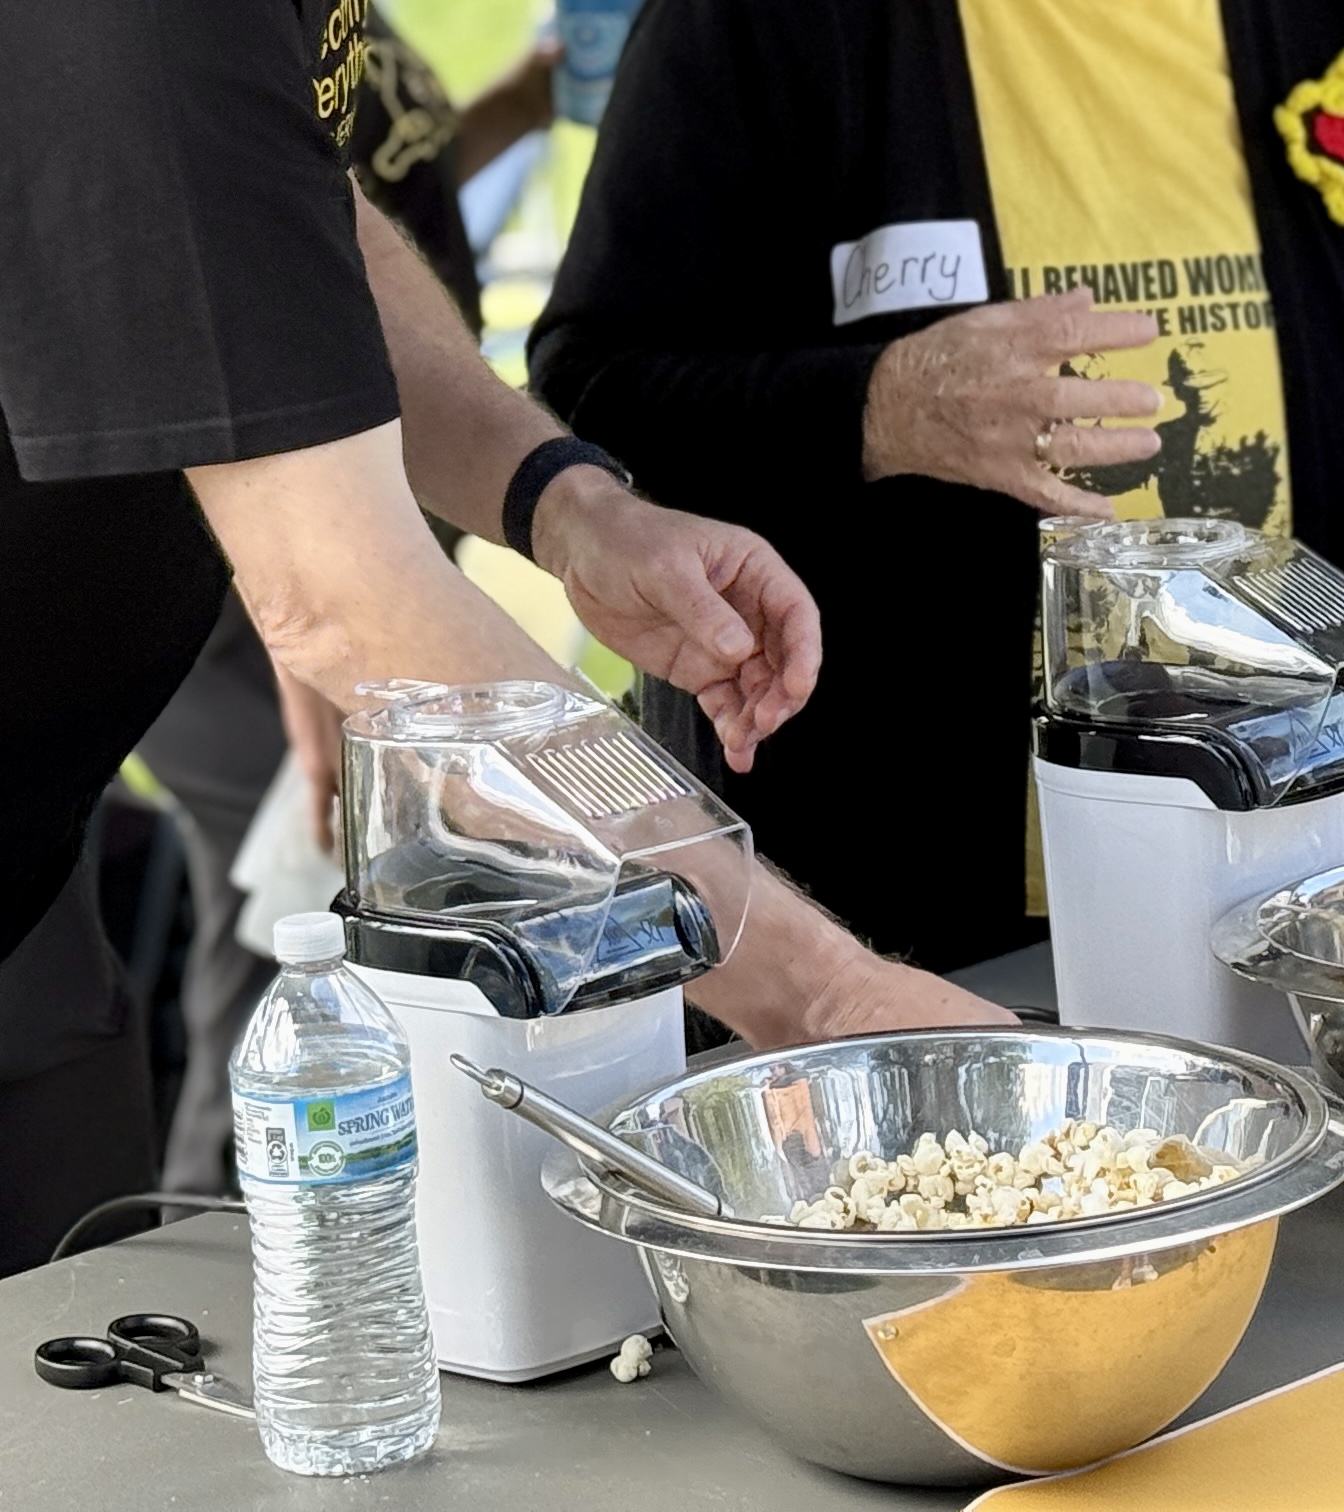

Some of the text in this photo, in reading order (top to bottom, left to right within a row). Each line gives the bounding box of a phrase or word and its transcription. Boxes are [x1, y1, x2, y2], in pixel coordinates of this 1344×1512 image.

[843, 244, 962, 309] Cherry
[1043, 259, 1179, 304] BEHAVED
[1183, 252, 1265, 297] WOM
[337, 1107, 390, 1136] SPRING
